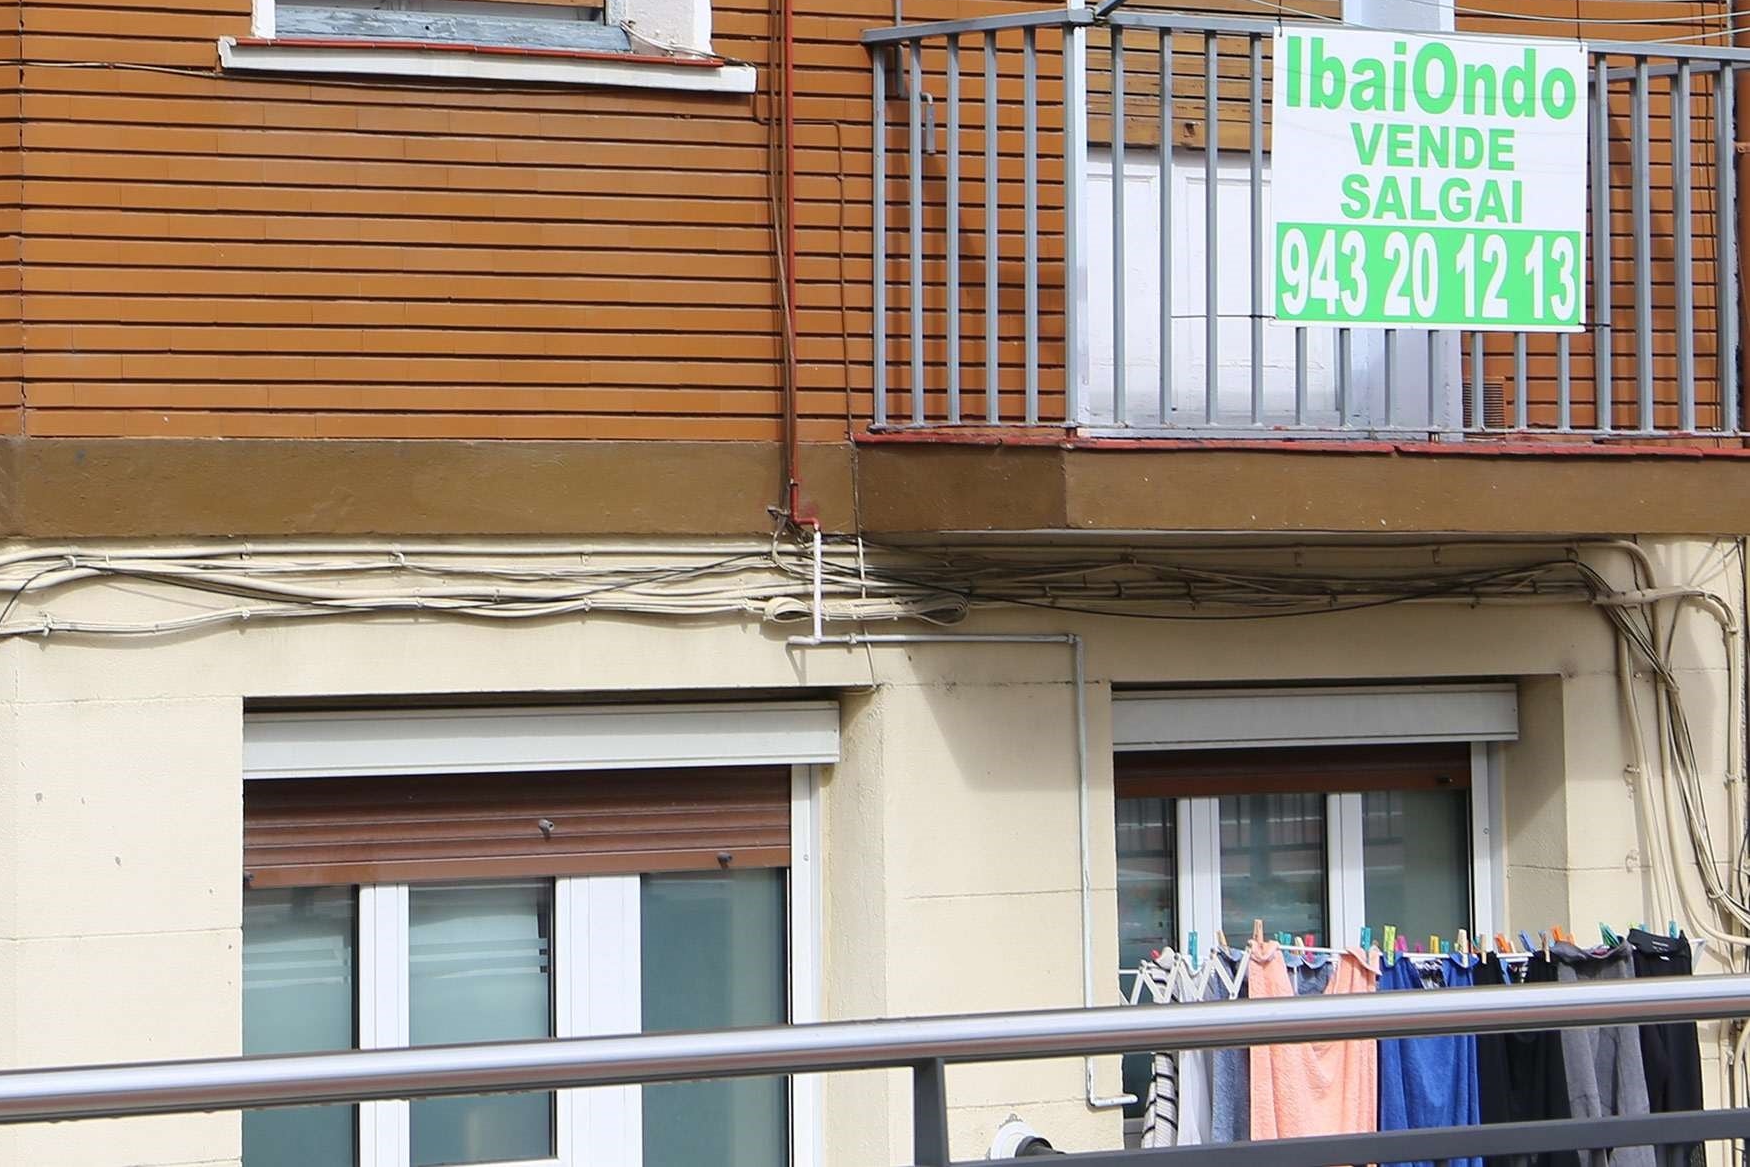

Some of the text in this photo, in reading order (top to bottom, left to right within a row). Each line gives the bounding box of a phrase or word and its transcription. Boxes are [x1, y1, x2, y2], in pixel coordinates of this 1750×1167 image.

[1286, 35, 1577, 120] IbaiOndo
[1350, 122, 1516, 171] VENDE
[1340, 173, 1523, 224] SALGAI
[1281, 227, 1577, 321] 943 20 12 13
